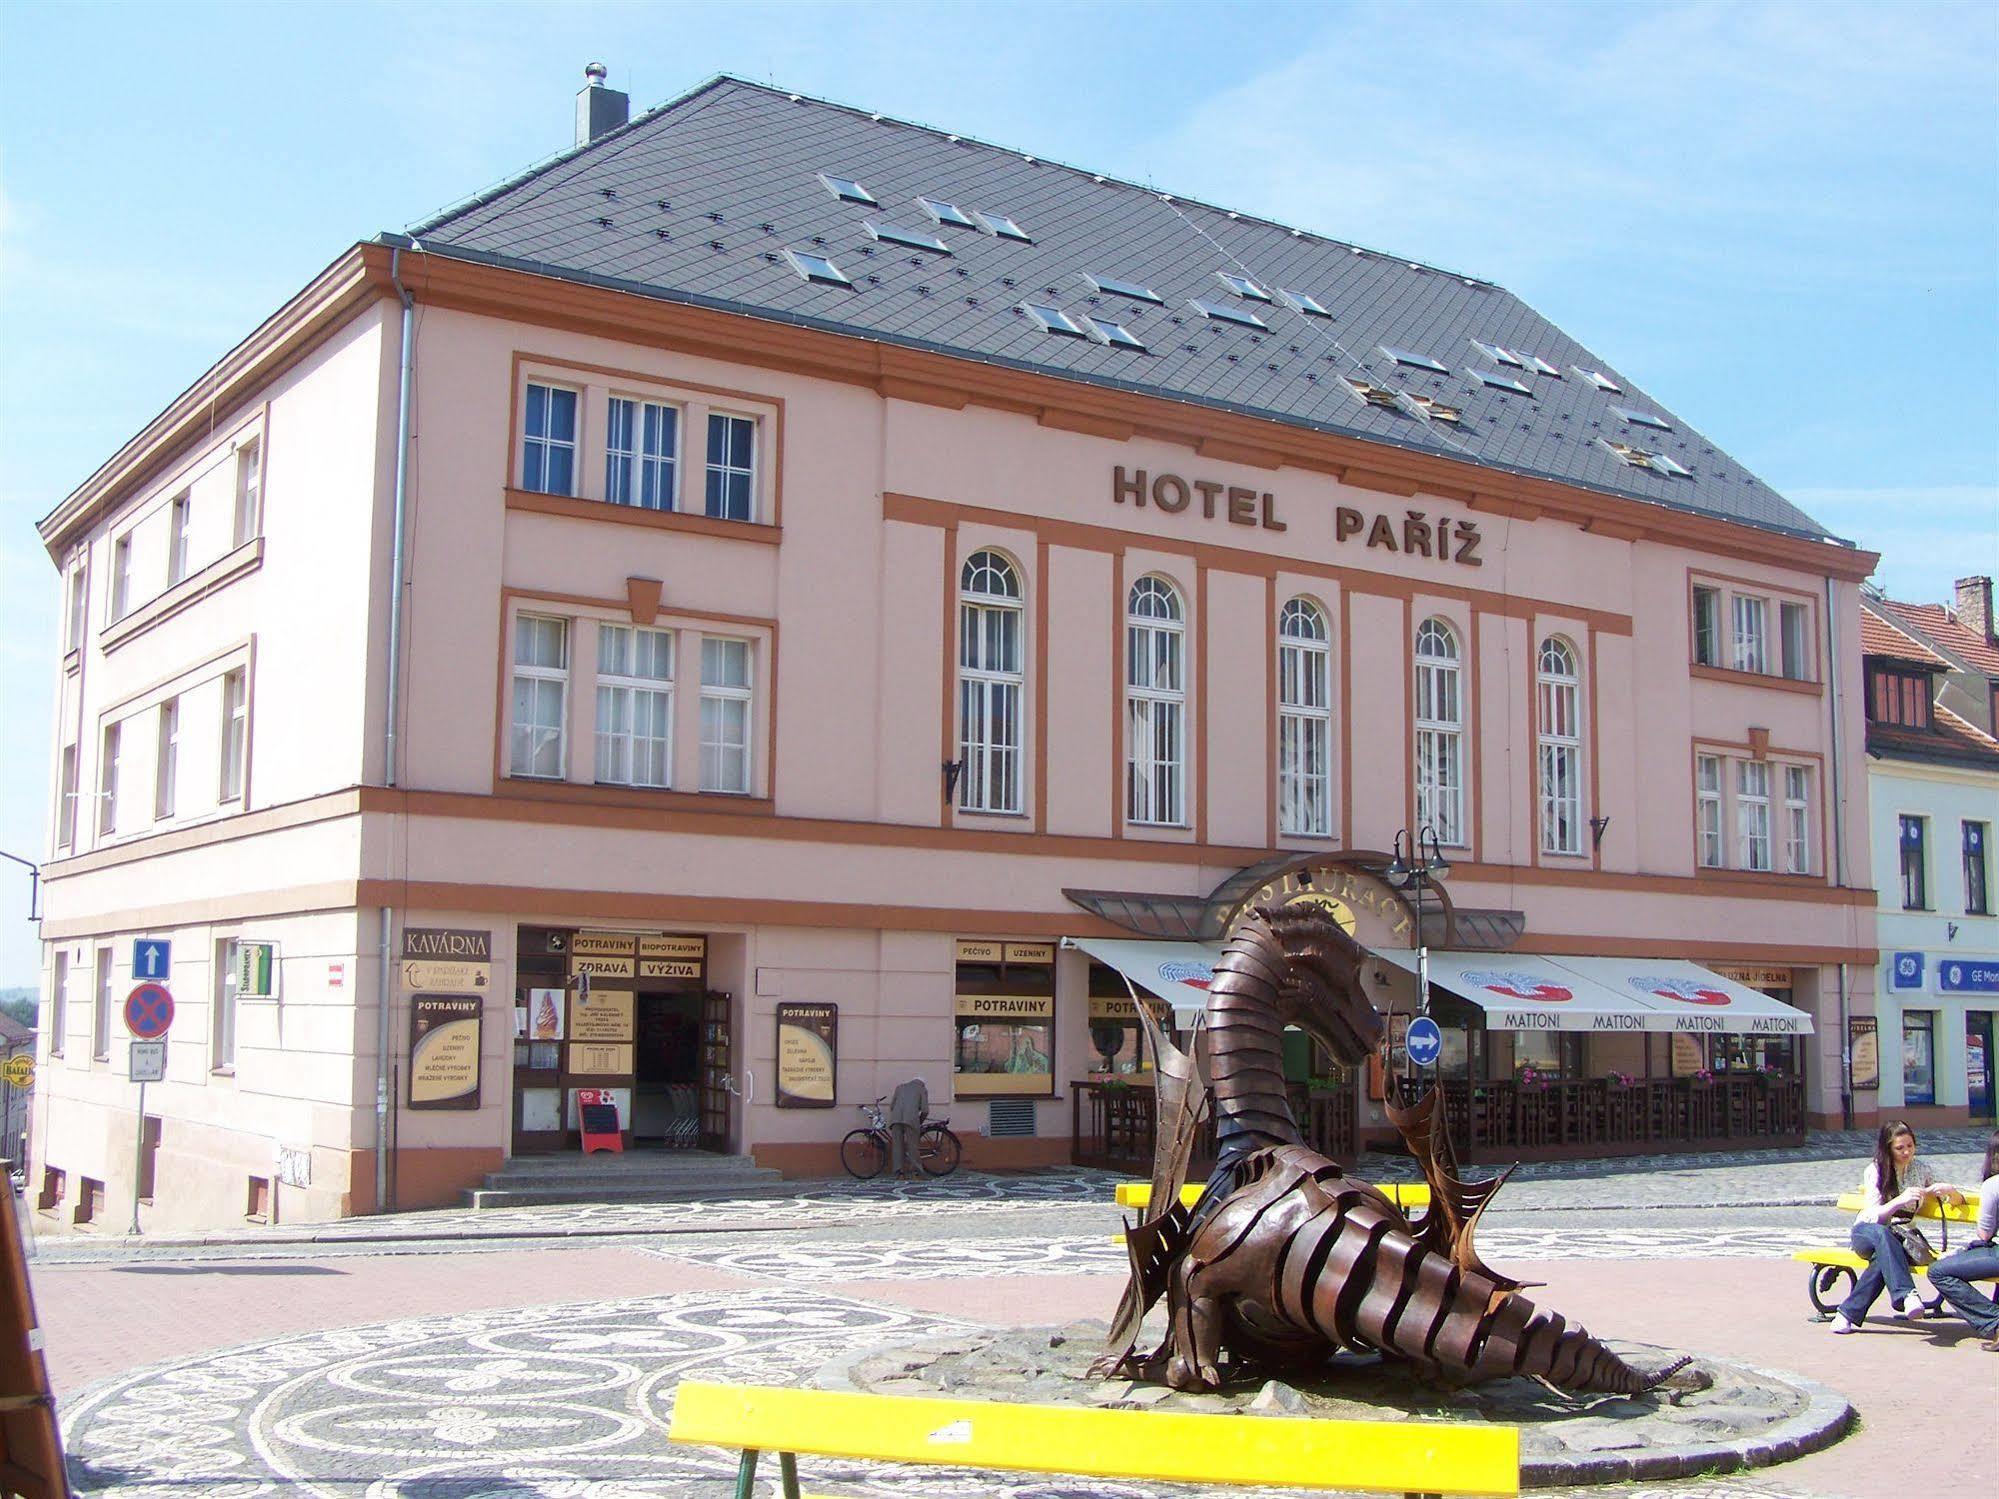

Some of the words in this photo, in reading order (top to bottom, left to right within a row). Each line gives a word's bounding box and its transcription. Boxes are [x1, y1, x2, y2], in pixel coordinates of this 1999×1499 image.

[1113, 465, 1287, 532] HOTEL
[1336, 507, 1482, 567] PAŘÍŽ
[407, 932, 487, 956] KAVÁRNA
[574, 939, 634, 950] POTRAVINY
[642, 943, 701, 952] BIOPOTRAVINY
[962, 947, 991, 956] PEČIVO
[1013, 949, 1046, 957] UZENINY
[578, 961, 628, 974] ZDRAVÁ
[647, 961, 694, 976] VÝŽIVA
[1971, 970, 1982, 982] GE
[418, 1002, 477, 1011] POTRAVINY
[782, 1009, 831, 1017] POTRAVINY
[974, 1000, 1046, 1013] POTRAVINY
[1504, 1013, 1560, 1028] MATTONI
[1592, 1015, 1645, 1029] MATTONI
[1675, 1016, 1725, 1030] MATTONI
[1751, 1018, 1797, 1031] MATTONI
